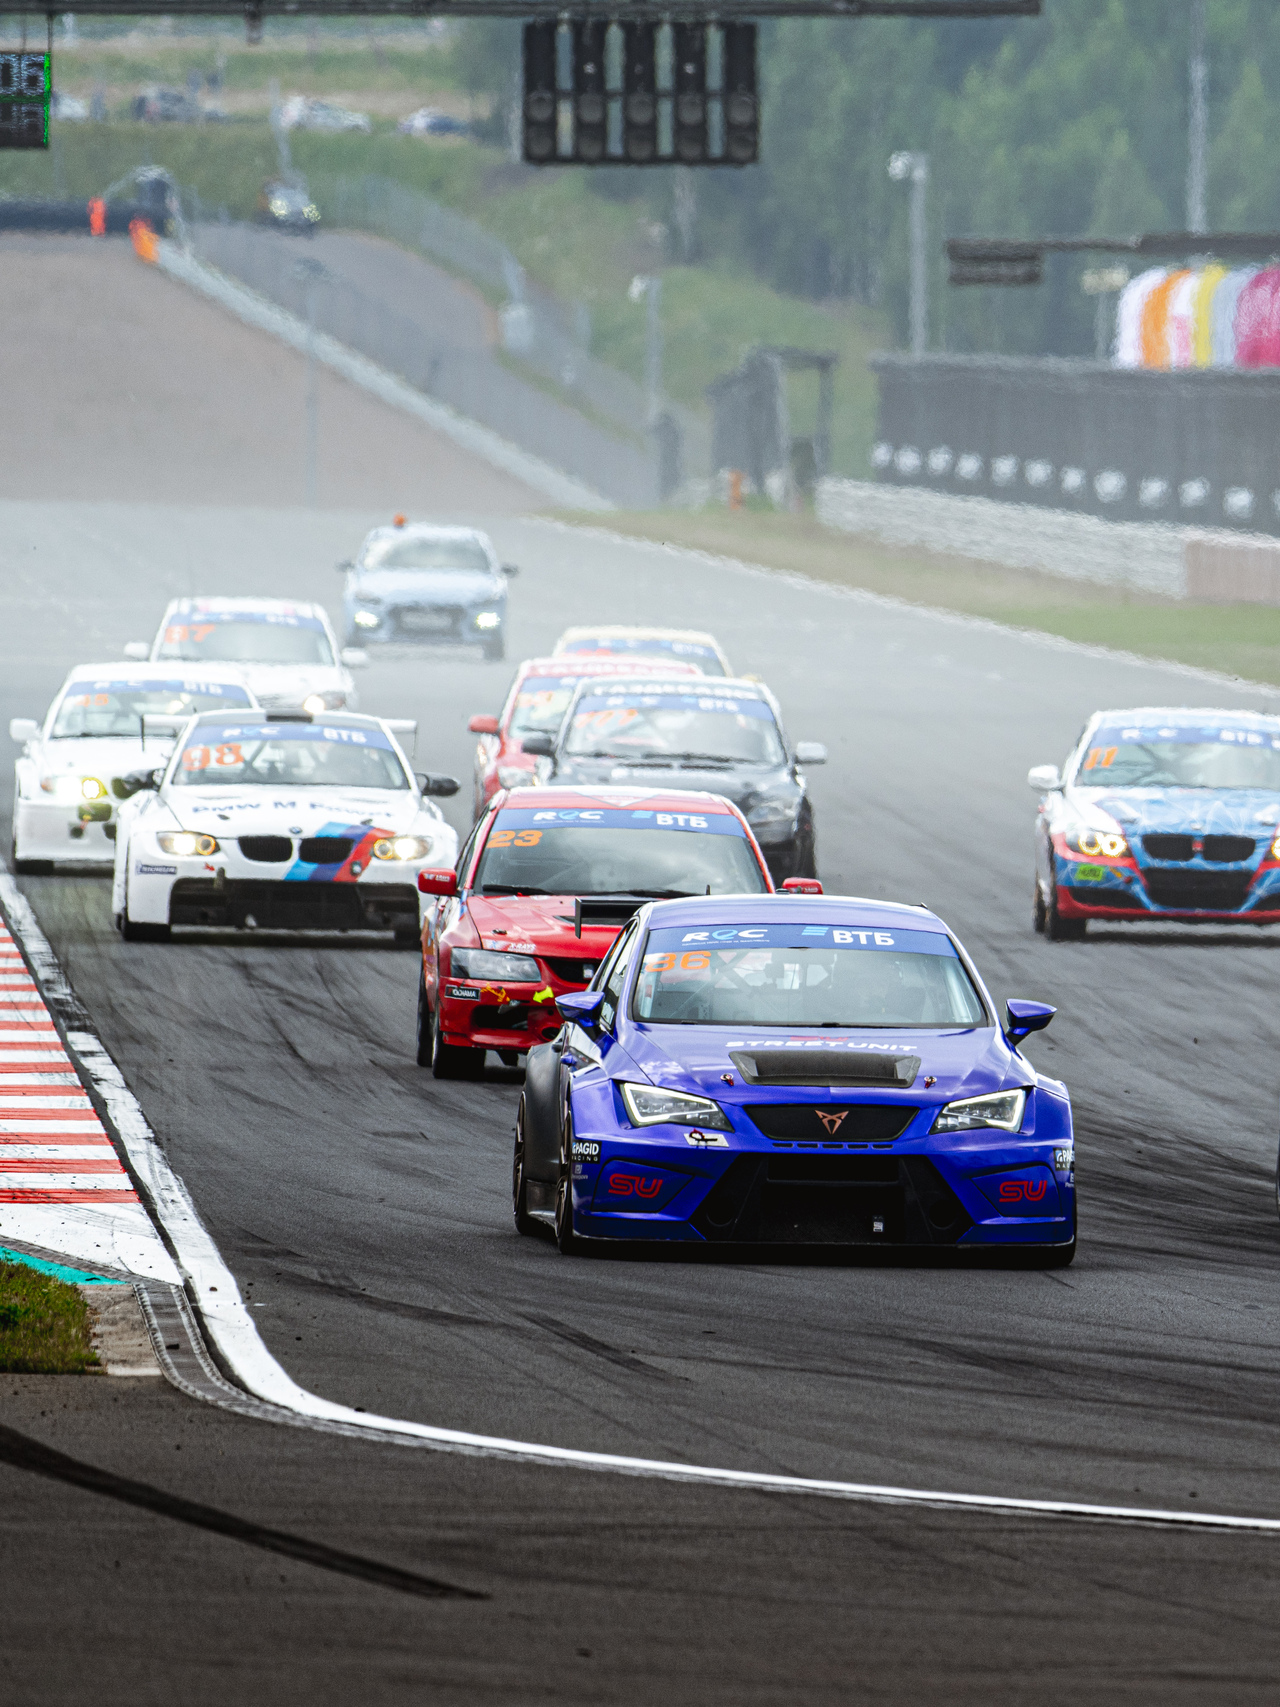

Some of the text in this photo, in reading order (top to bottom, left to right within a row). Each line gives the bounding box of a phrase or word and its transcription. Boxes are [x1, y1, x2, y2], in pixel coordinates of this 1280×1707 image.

[324, 729, 367, 744] ВТБ
[182, 743, 245, 771] 98
[273, 801, 297, 809] M
[656, 813, 709, 828] ВТБ
[486, 829, 543, 848] 23
[832, 930, 895, 946] ВТБ
[645, 950, 712, 972] 86
[848, 1042, 918, 1051] UNIT
[575, 1142, 600, 1155] PAGID
[608, 1173, 663, 1199] SU
[999, 1180, 1048, 1202] SU
